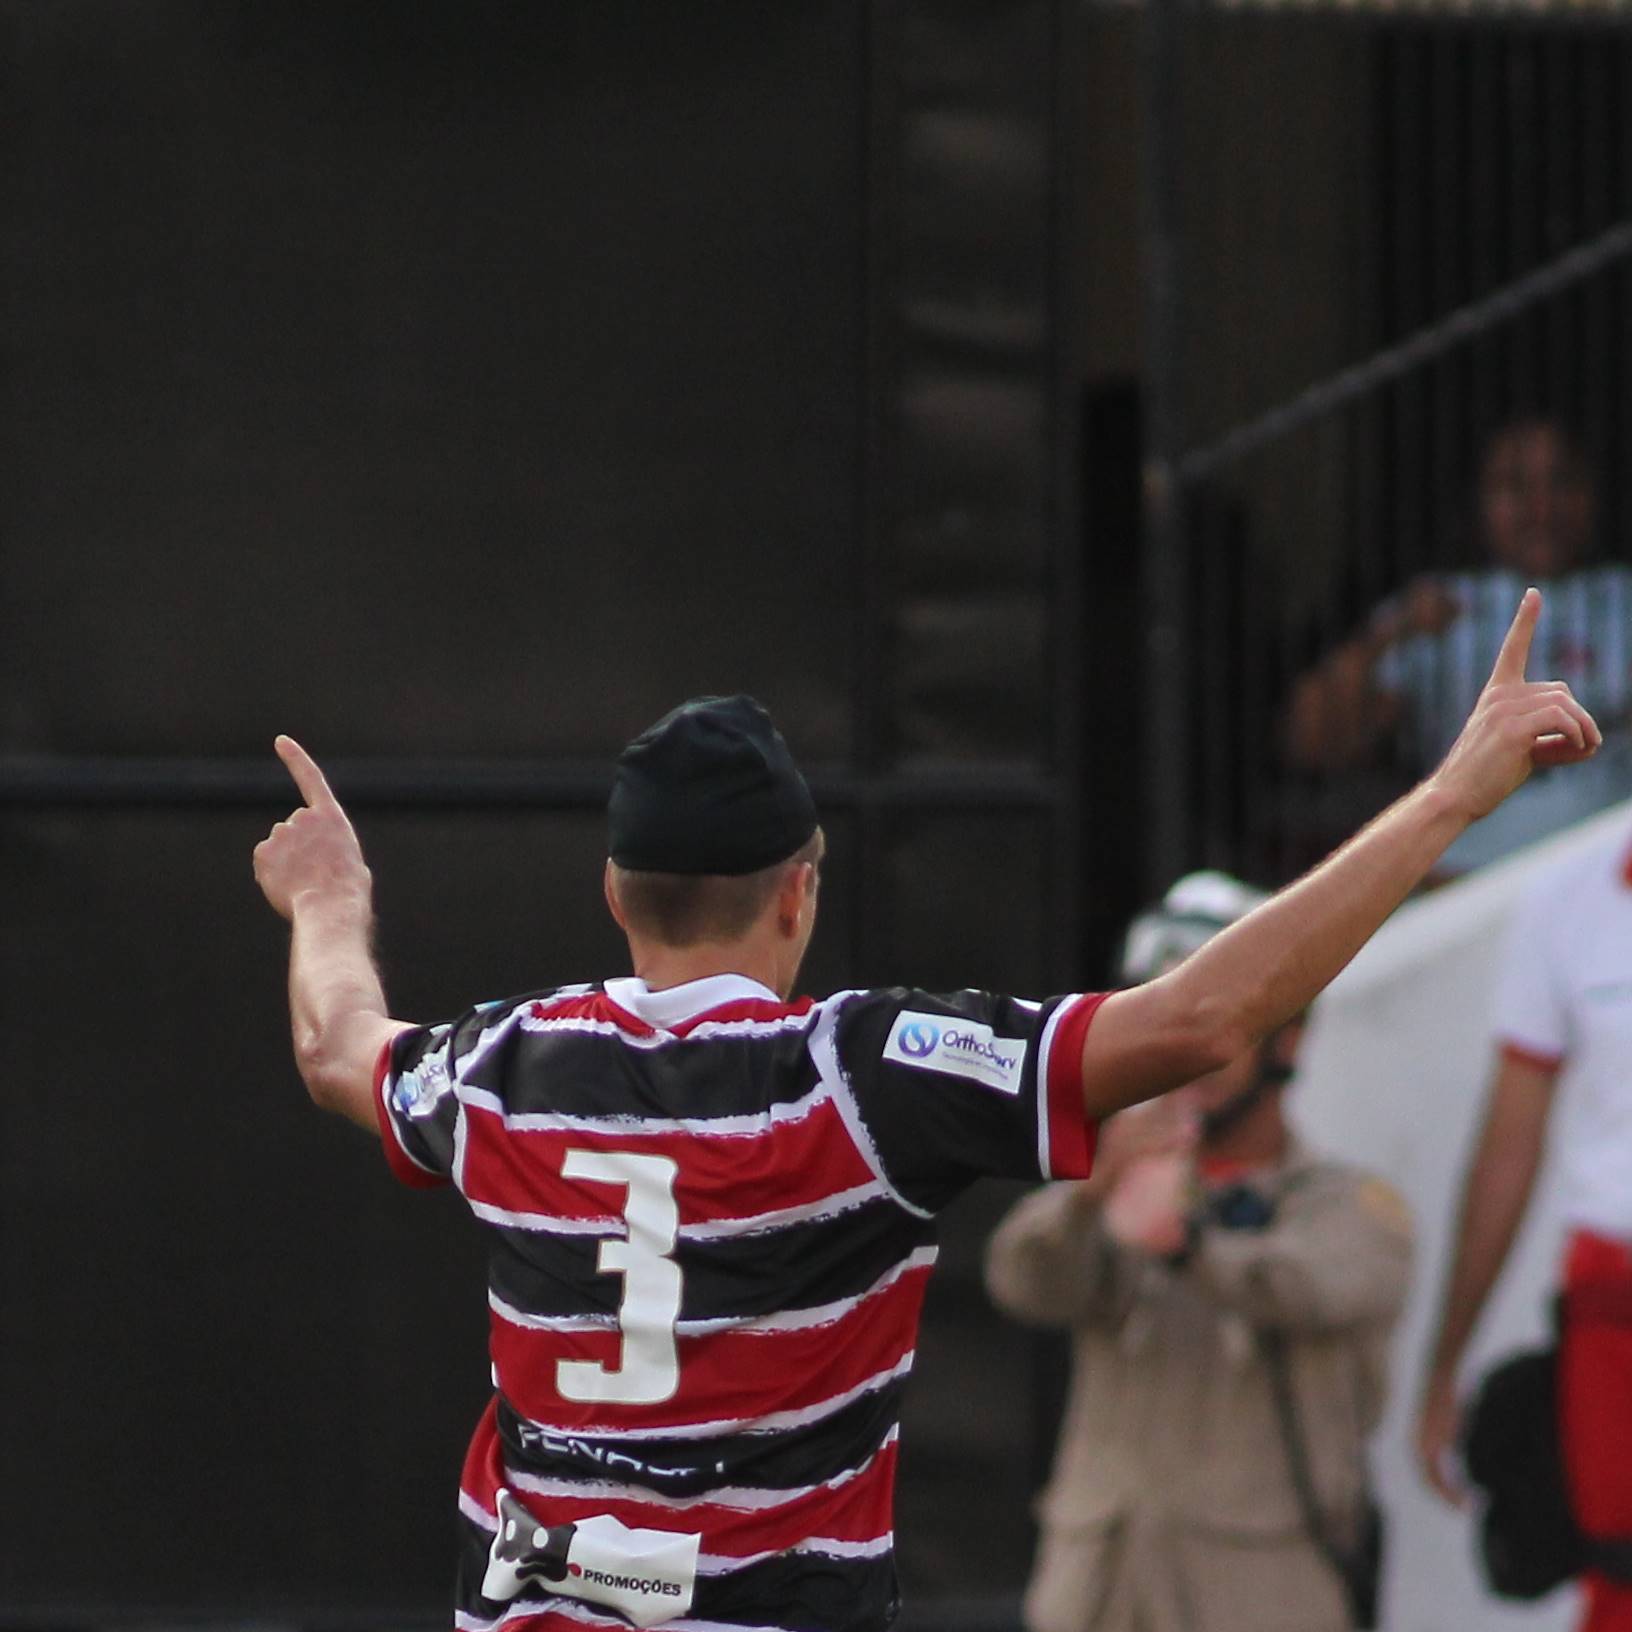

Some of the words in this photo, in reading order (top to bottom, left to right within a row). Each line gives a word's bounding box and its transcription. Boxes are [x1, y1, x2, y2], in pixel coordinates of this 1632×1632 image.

[942, 1029, 1017, 1070] OrthoSrv
[556, 1148, 683, 1404] 3
[583, 1568, 682, 1597] PROMOÇÕES
